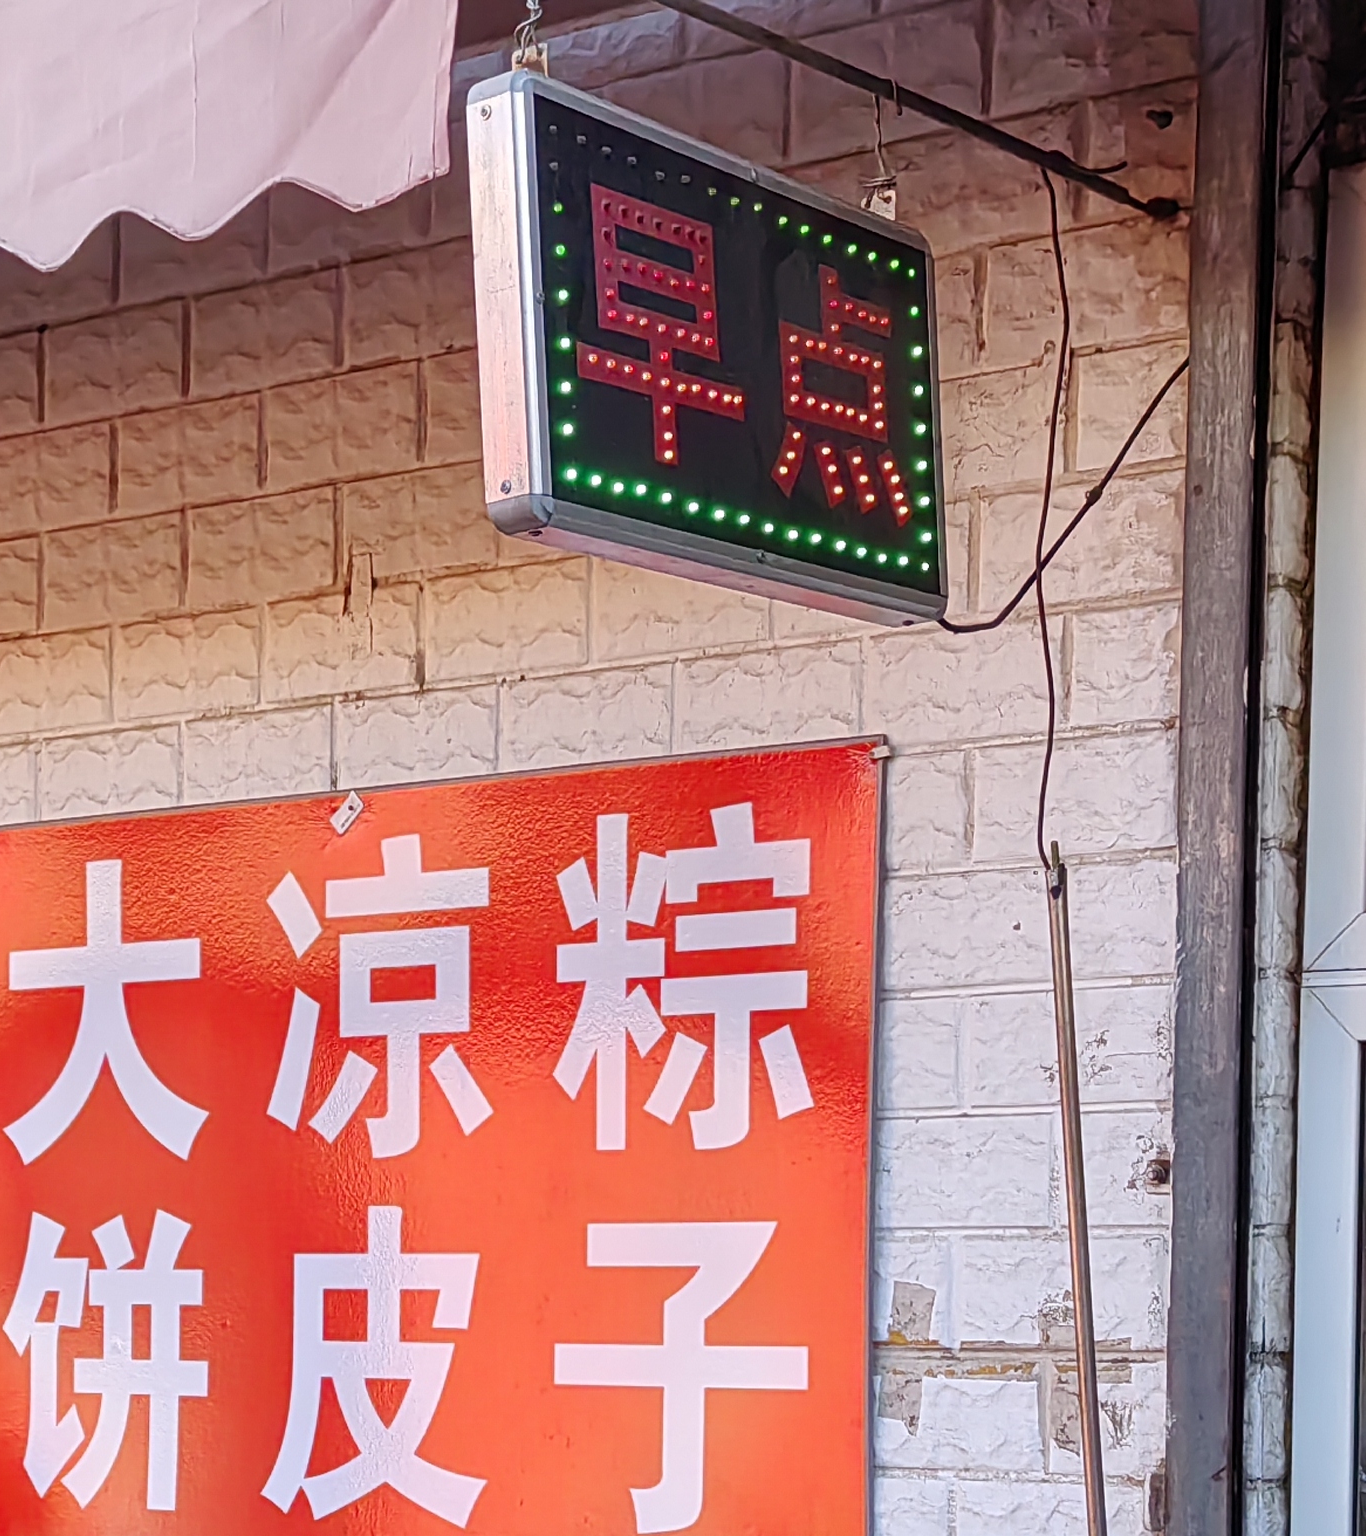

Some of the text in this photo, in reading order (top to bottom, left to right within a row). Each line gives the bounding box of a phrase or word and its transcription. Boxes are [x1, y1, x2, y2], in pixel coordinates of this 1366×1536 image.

[576, 183, 911, 527] 早点
[2, 859, 210, 1511] 大饼
[260, 834, 494, 1529] 凉皮
[552, 801, 813, 1534] 粽子
